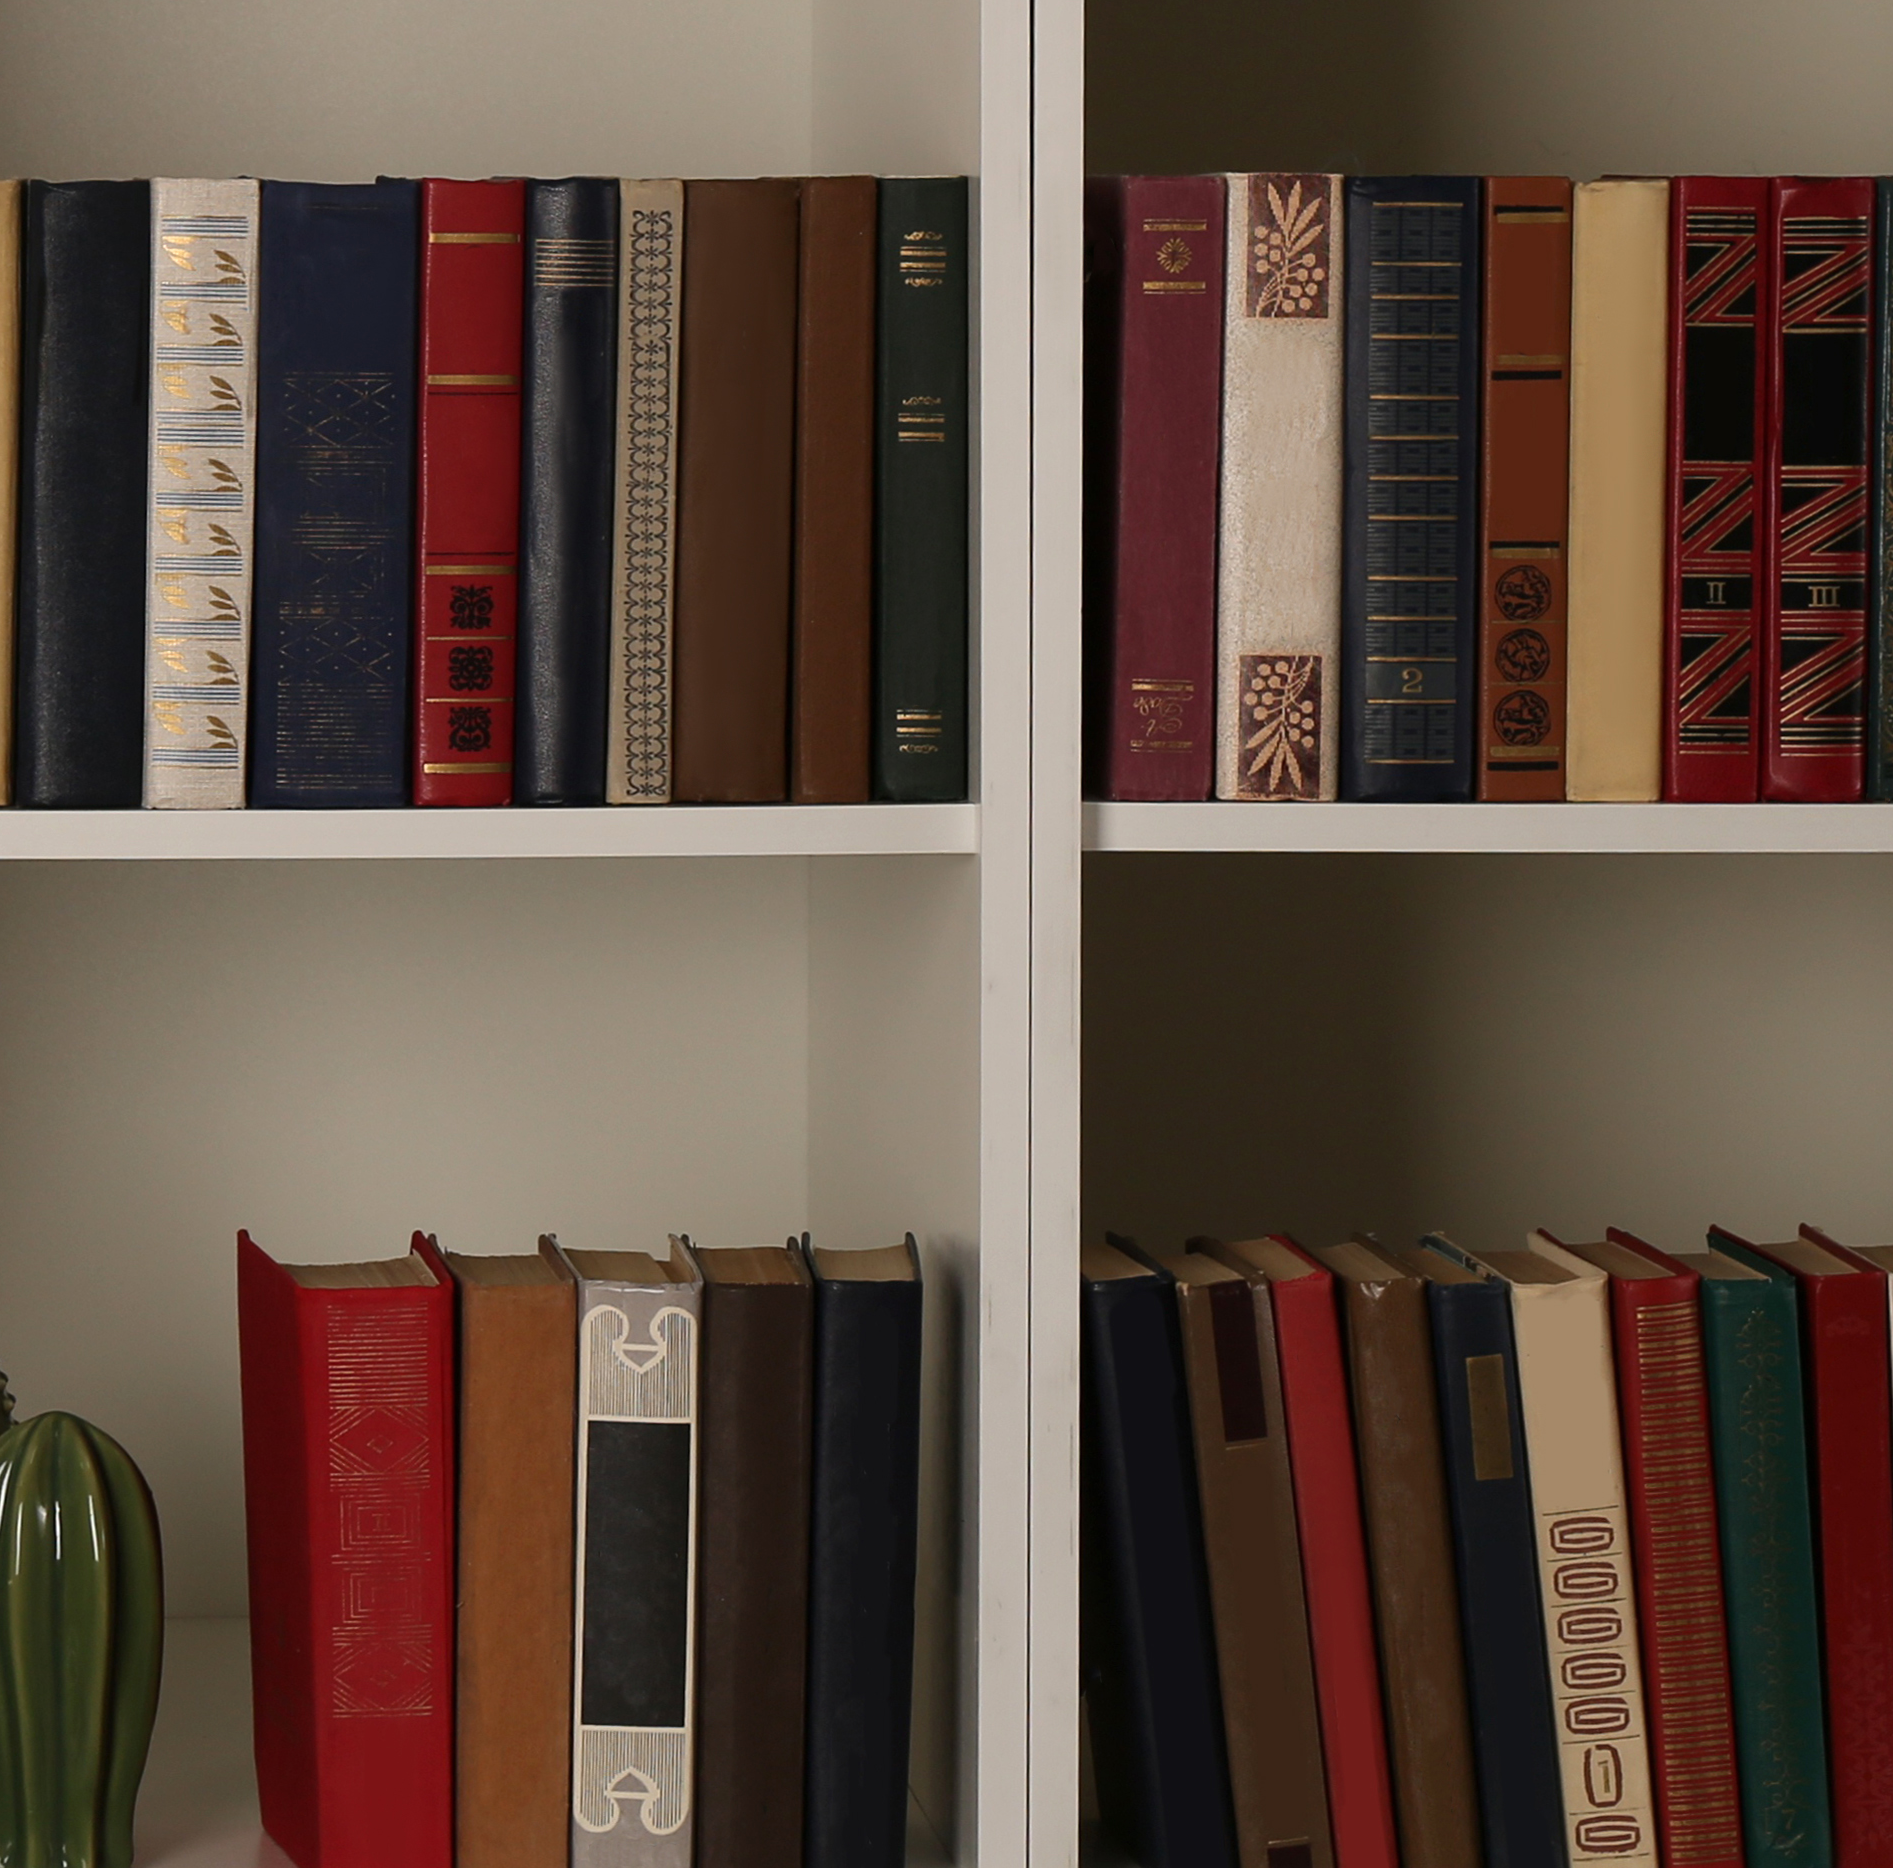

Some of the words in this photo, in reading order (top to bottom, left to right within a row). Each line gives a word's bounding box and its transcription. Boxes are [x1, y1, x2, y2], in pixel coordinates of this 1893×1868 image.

[1706, 582, 1727, 604] II
[1807, 586, 1841, 608] III
[1402, 667, 1423, 693] 2
[1598, 1759, 1611, 1794] 1
